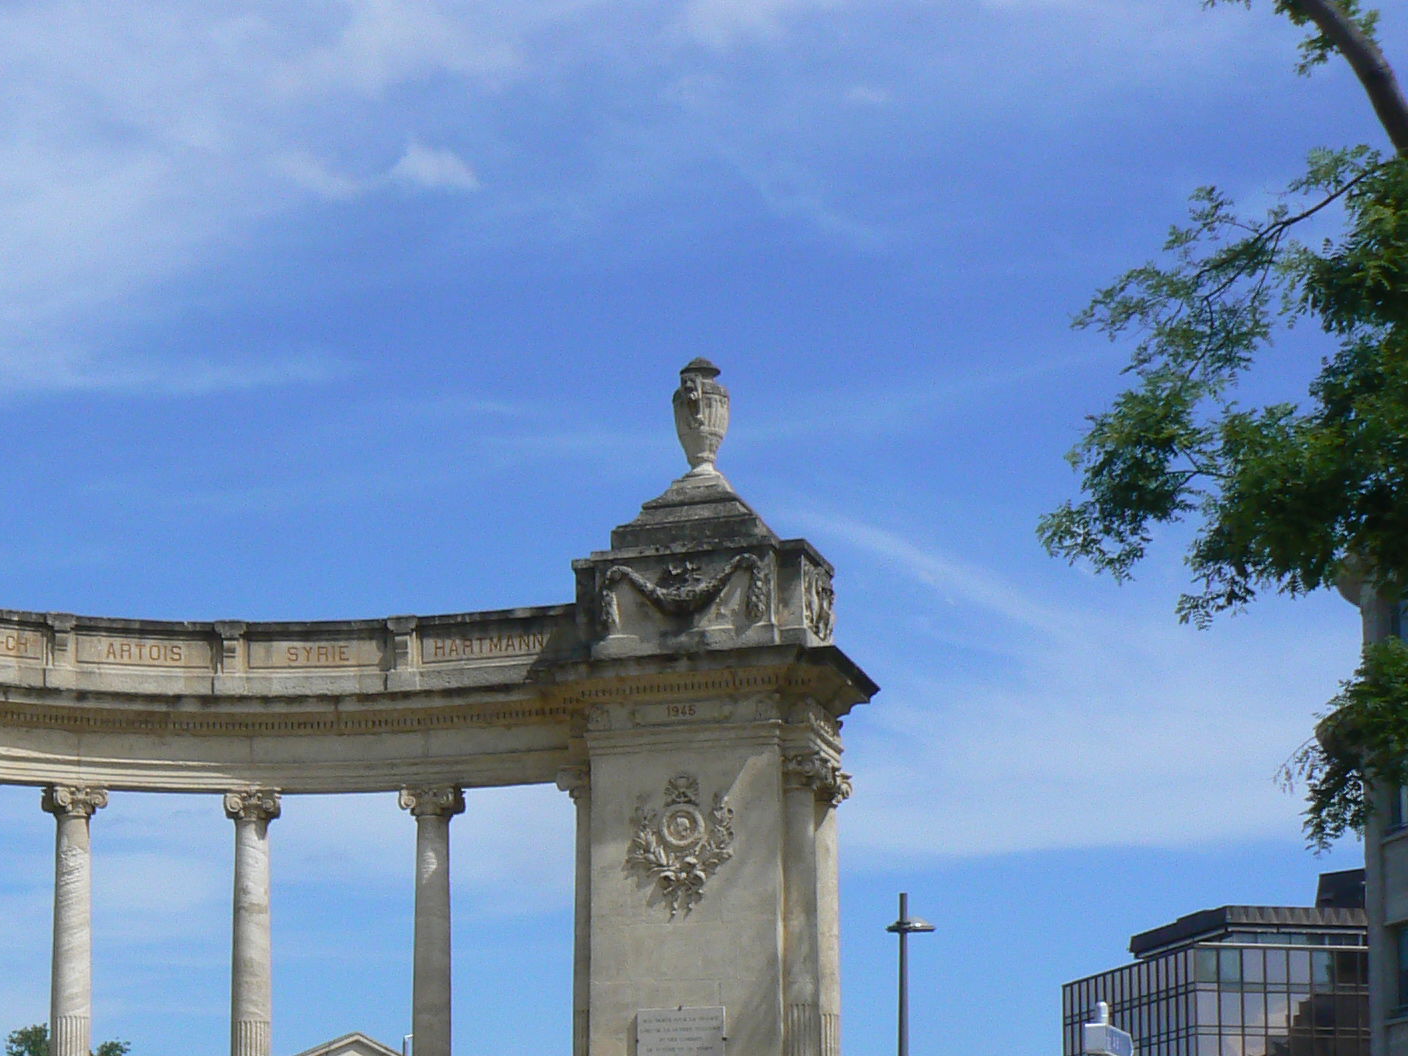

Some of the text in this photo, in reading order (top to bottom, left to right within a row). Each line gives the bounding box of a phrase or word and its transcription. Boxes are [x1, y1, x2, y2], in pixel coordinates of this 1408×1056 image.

[106, 642, 182, 662] ARTOIS
[287, 645, 350, 663] SYRIE
[433, 633, 544, 657] HARTMANN
